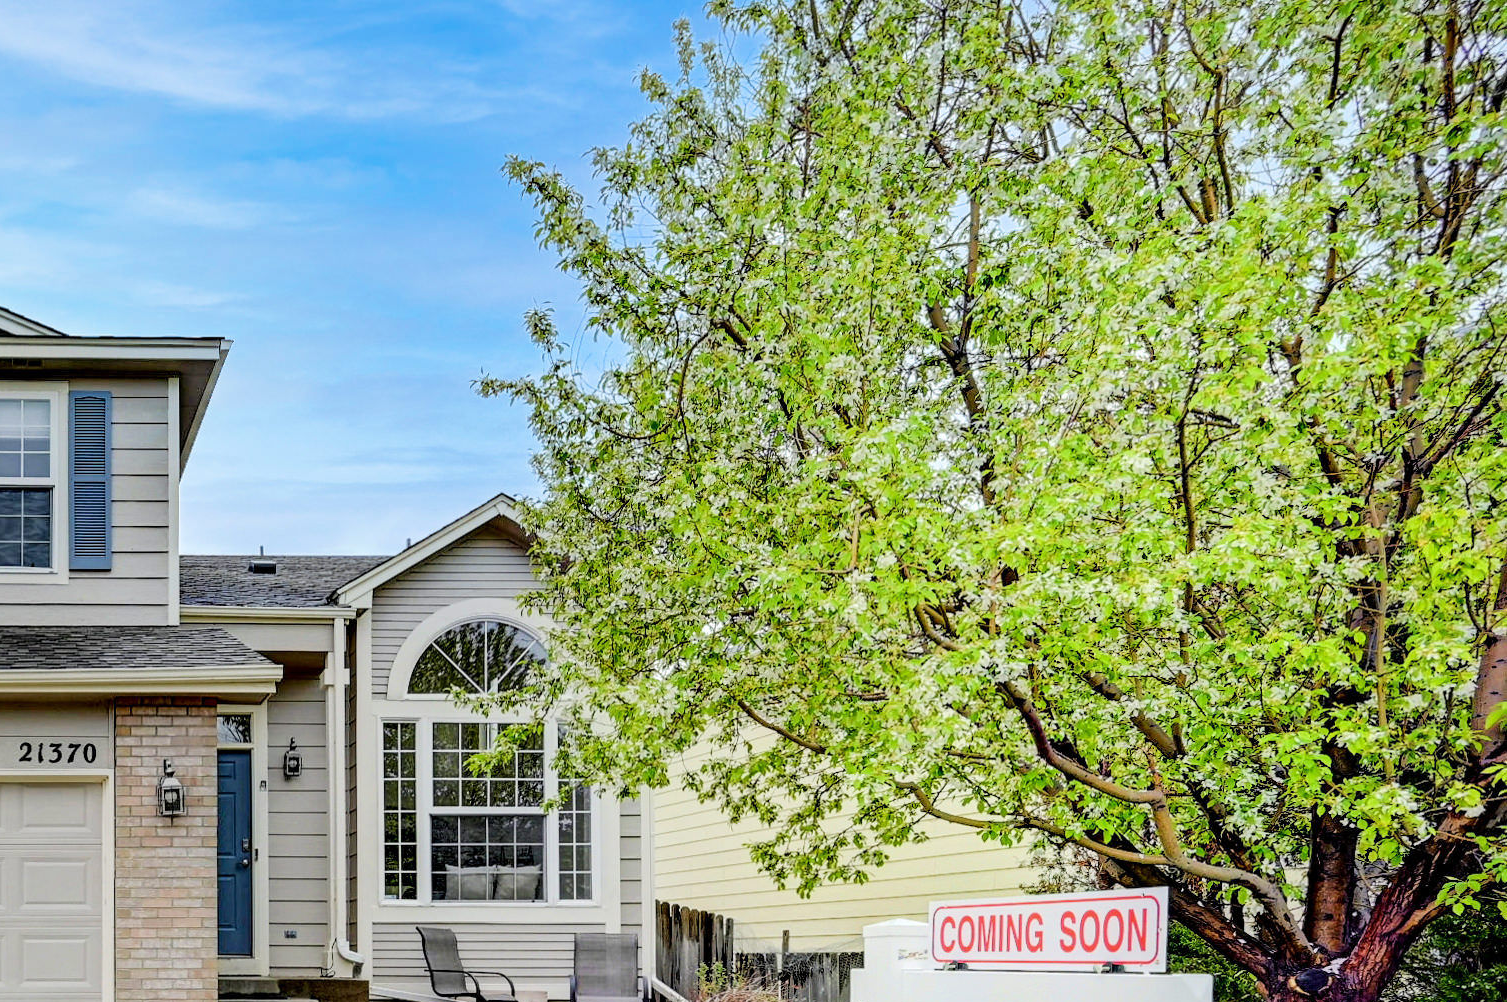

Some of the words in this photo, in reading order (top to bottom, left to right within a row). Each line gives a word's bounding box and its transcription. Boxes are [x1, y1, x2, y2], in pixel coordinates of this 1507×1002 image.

[18, 742, 97, 764] 21370
[940, 913, 1044, 953] COMING
[1059, 908, 1148, 953] SOON
